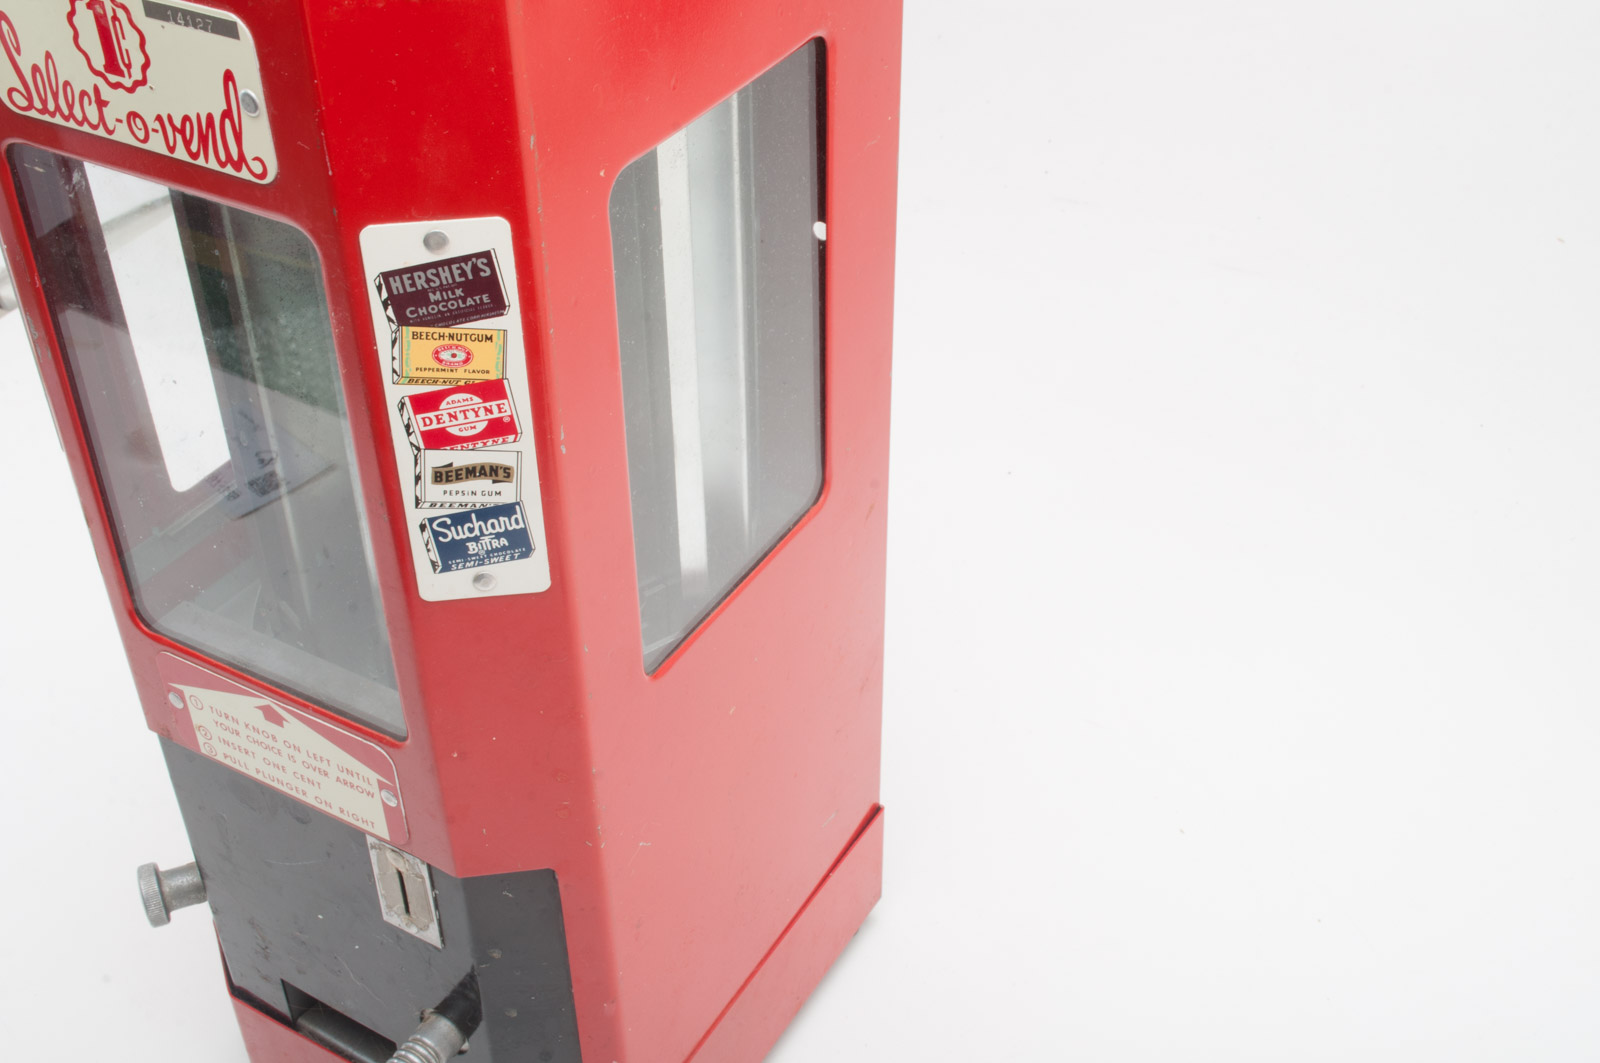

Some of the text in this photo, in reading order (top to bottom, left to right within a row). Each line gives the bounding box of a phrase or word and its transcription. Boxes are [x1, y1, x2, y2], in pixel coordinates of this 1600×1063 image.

[388, 257, 492, 295] HERSHEY'S
[405, 294, 491, 318] CHOCOLATE
[428, 287, 465, 303] MILK
[445, 396, 474, 406] ADAMS
[421, 403, 508, 428] DENTYNE
[458, 425, 477, 433] GUM
[433, 465, 512, 483] BEEMAN'S
[432, 504, 525, 542] Suchard
[451, 553, 520, 570] SEMI-SWEET
[489, 547, 526, 557] CHOCOLATE
[209, 705, 240, 726] TURN
[244, 721, 278, 743] KNOB
[283, 740, 301, 754] ON
[306, 750, 331, 768] LEFT
[337, 763, 373, 786] UNTIL
[213, 719, 375, 799] YOUR CHOICE IS OVER ARROW
[218, 736, 256, 759] INSERT
[262, 757, 288, 774] ONE
[292, 771, 322, 790] CENT
[223, 752, 250, 771] PULL
[255, 767, 308, 798] PLUNGER
[314, 795, 333, 811] ON
[338, 807, 376, 829] RIGHT
